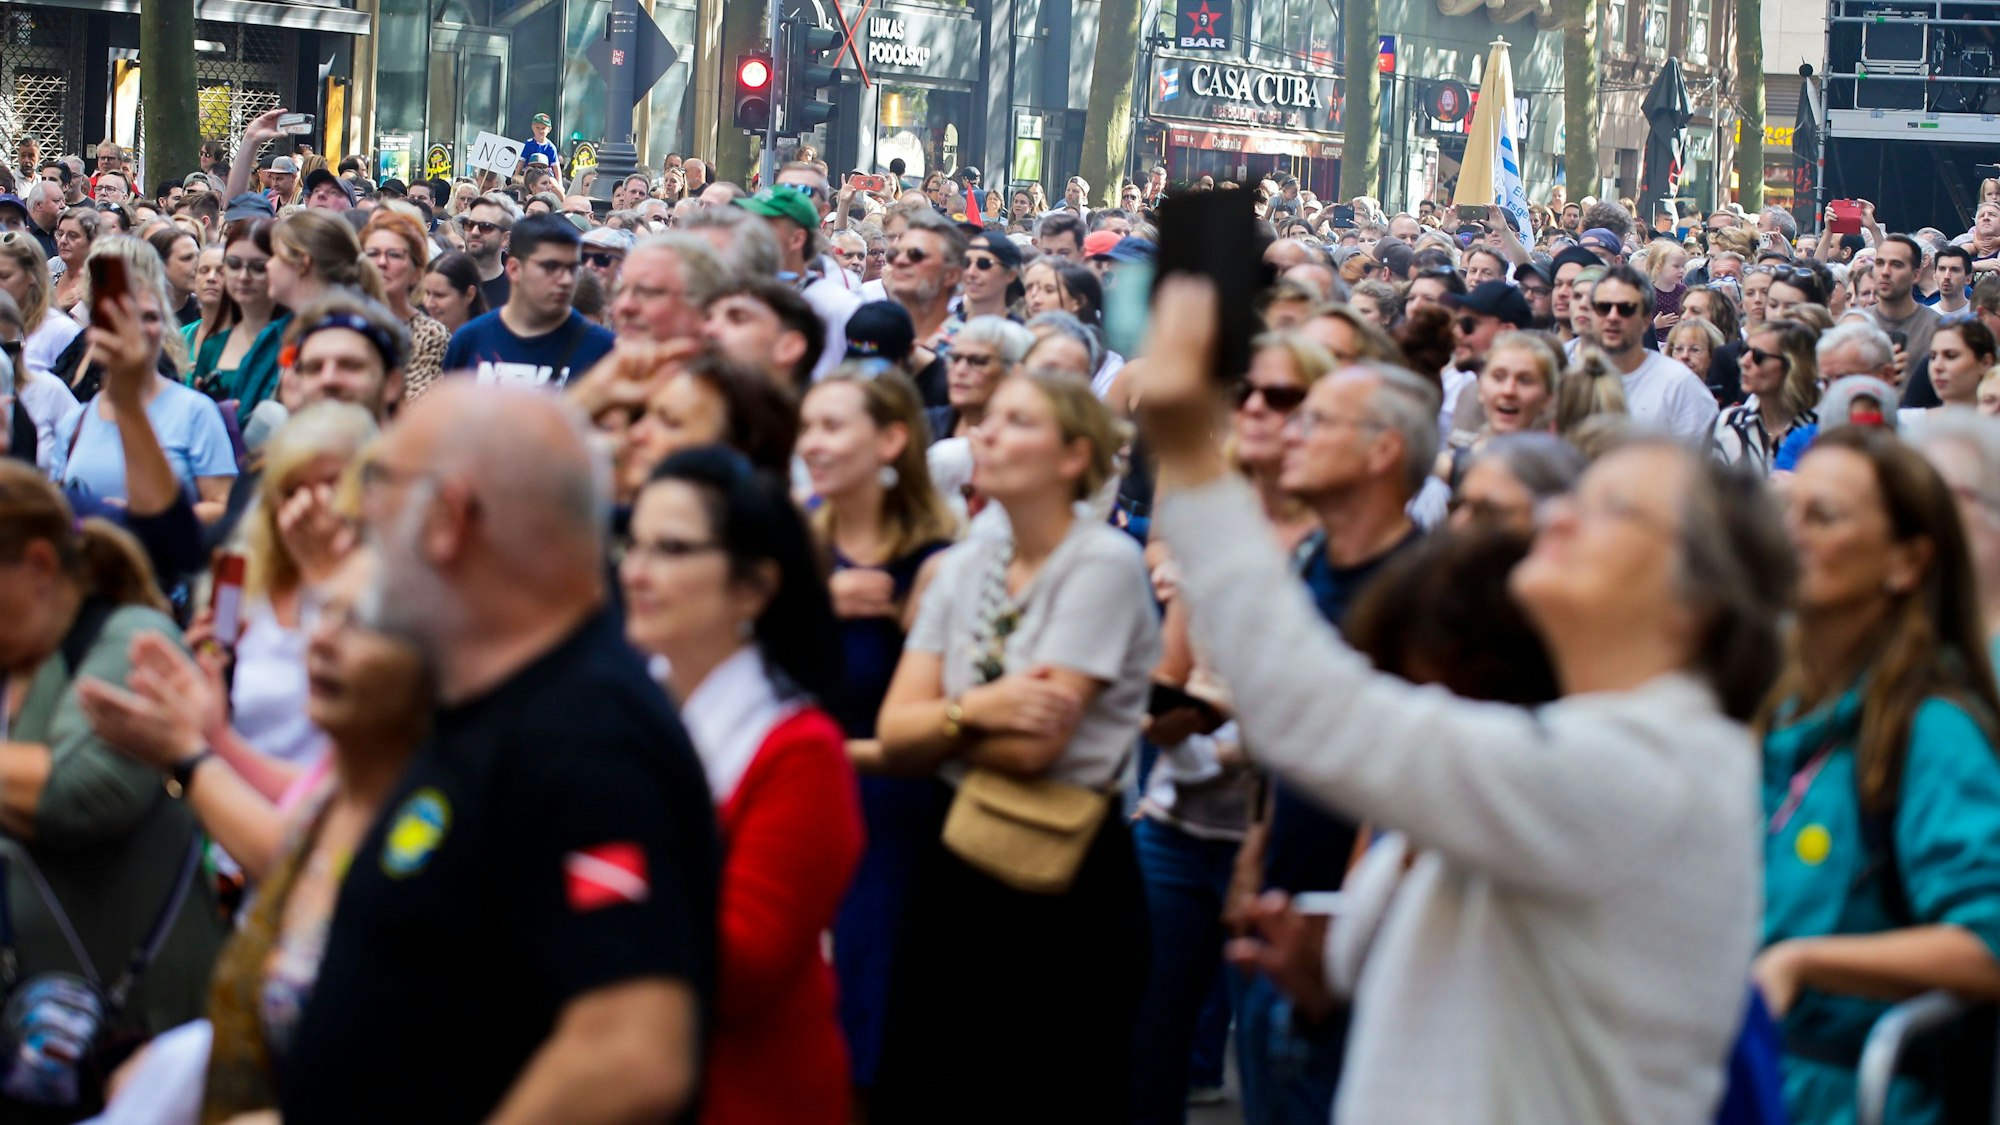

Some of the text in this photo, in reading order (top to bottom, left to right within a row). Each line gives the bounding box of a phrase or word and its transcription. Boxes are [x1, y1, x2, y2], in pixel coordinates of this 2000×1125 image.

[869, 16, 905, 40] LUKAS
[1180, 37, 1226, 49] BAR
[1191, 64, 1323, 109] CASA CUBA
[1211, 135, 1242, 150] Cocktails
[1321, 144, 1343, 159] Lounge
[478, 141, 517, 169] NO
